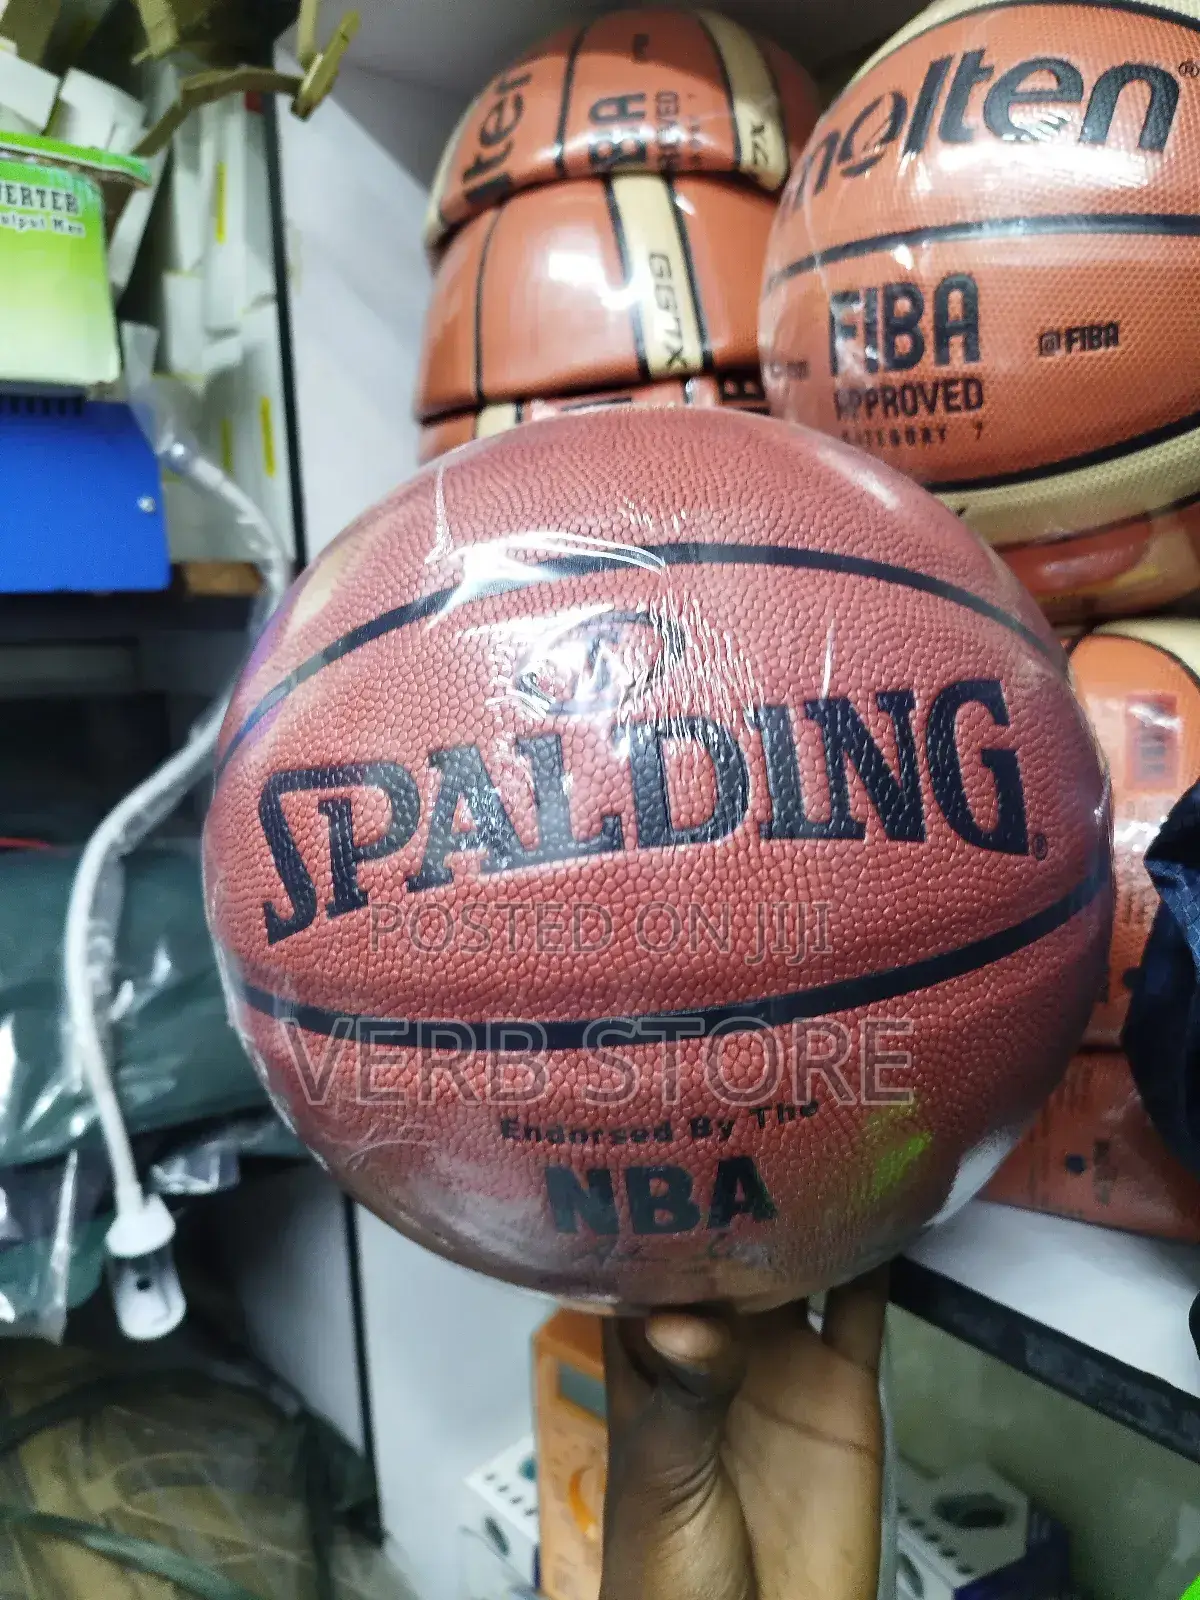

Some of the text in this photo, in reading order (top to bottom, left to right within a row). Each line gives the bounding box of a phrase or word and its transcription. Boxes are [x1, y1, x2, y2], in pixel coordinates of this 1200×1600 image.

[829, 273, 982, 377] FIBA
[1065, 322, 1119, 353] FIBA
[258, 678, 1032, 945] SPALDING
[500, 1117, 674, 1145] Endorsed
[690, 1116, 736, 1142] By
[544, 1156, 778, 1235] NBA
